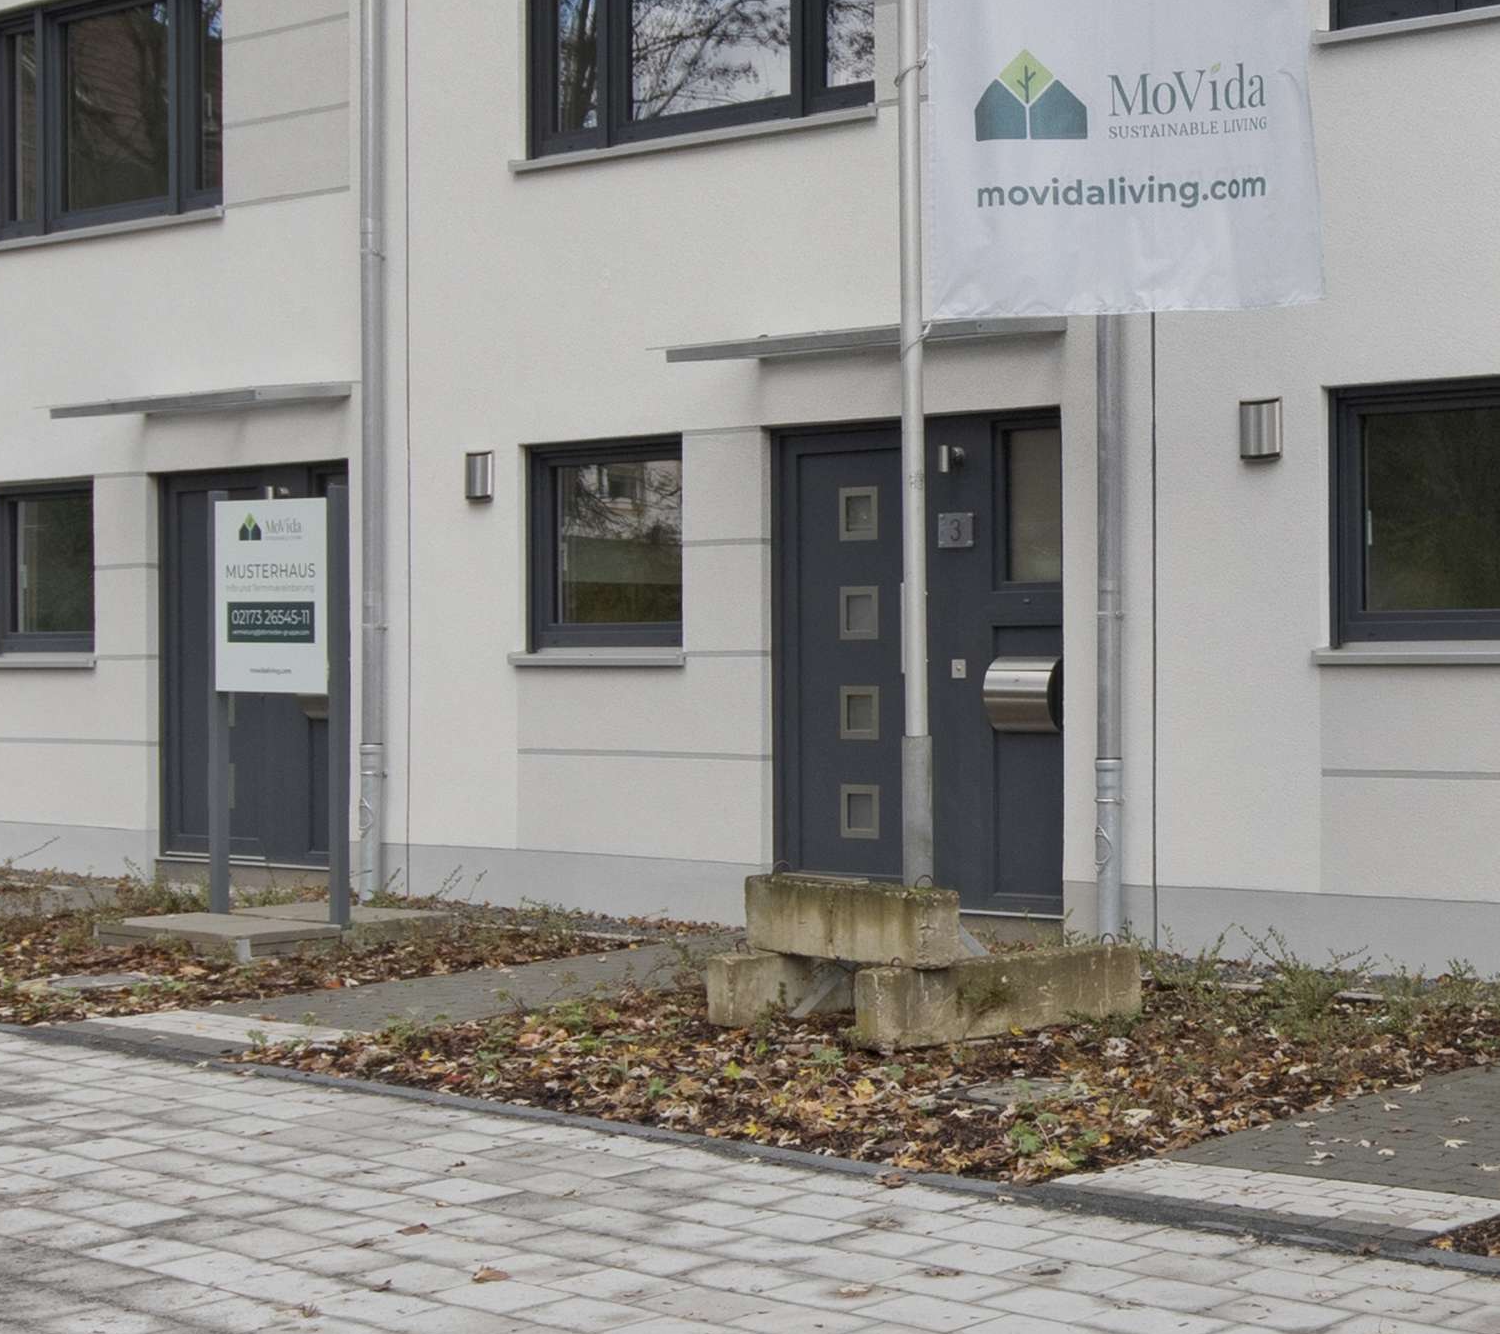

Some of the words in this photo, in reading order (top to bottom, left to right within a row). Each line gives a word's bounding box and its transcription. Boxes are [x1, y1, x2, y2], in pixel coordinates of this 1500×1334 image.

[1108, 63, 1266, 117] MoVida
[1108, 120, 1219, 140] SUSTAINABLE
[1223, 116, 1268, 134] LIVING
[977, 174, 1267, 209] movidaliving.com
[950, 519, 961, 542] 3
[225, 562, 316, 579] MUSTERHAUS
[231, 609, 262, 624] 02173
